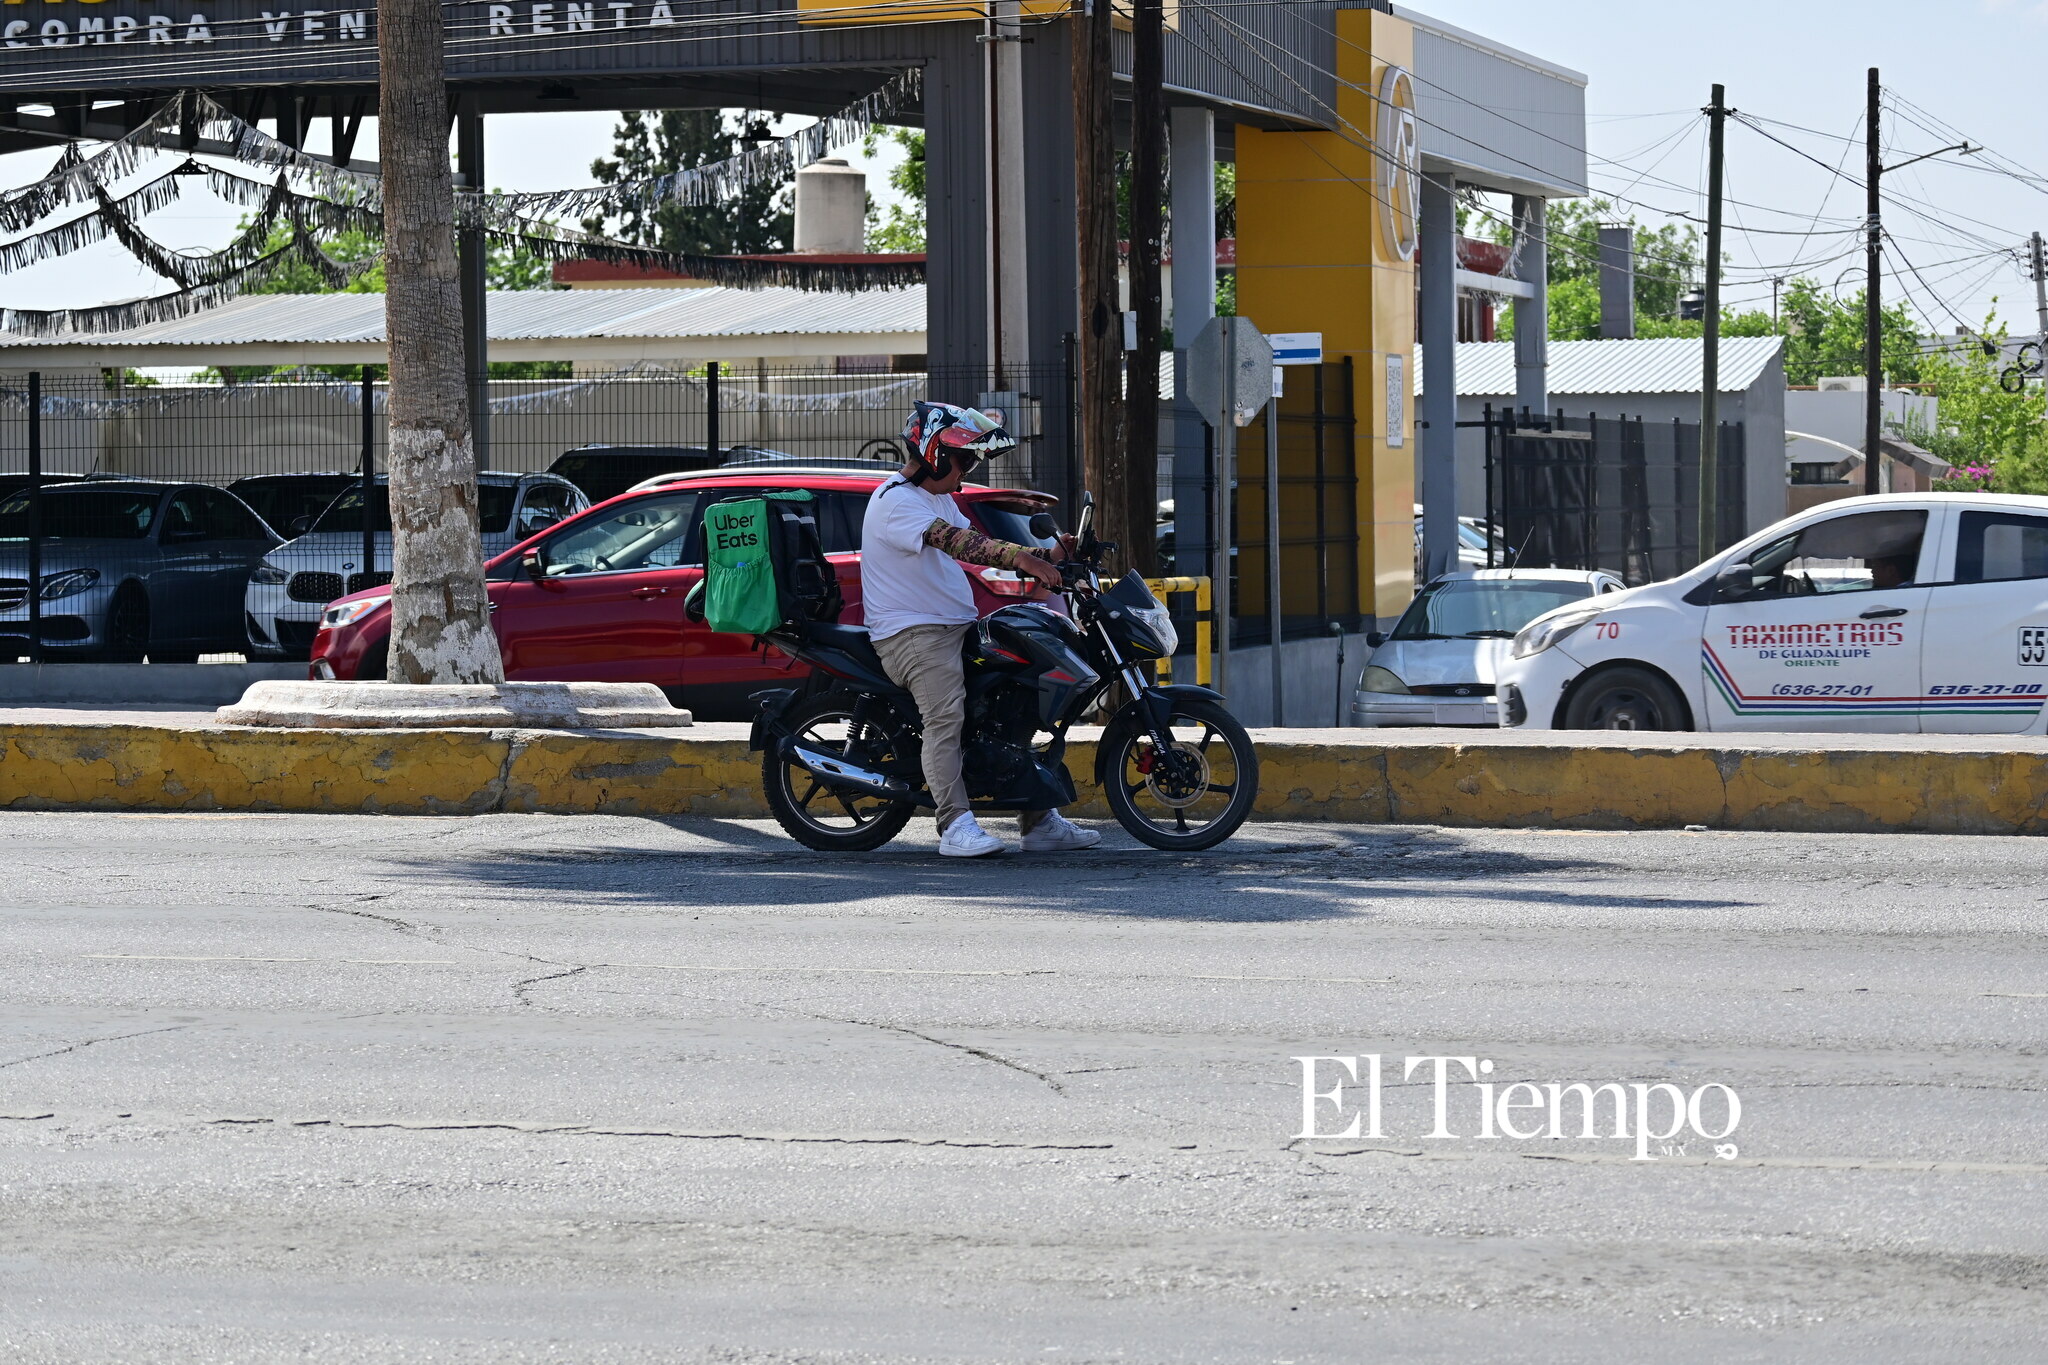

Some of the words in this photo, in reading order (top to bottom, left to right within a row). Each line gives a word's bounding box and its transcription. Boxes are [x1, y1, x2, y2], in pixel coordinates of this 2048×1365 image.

[4, 14, 214, 47] COMPRA
[262, 10, 367, 41] VEN
[489, 0, 675, 35] RENTA
[714, 514, 755, 531] Uber
[716, 532, 758, 549] Eats
[1595, 622, 1619, 640] 70
[1726, 622, 1903, 648] TAXIMETROS
[1759, 650, 1777, 659] DE
[1782, 649, 1871, 658] GUADALUPE
[1928, 684, 2043, 695] 636-27-00
